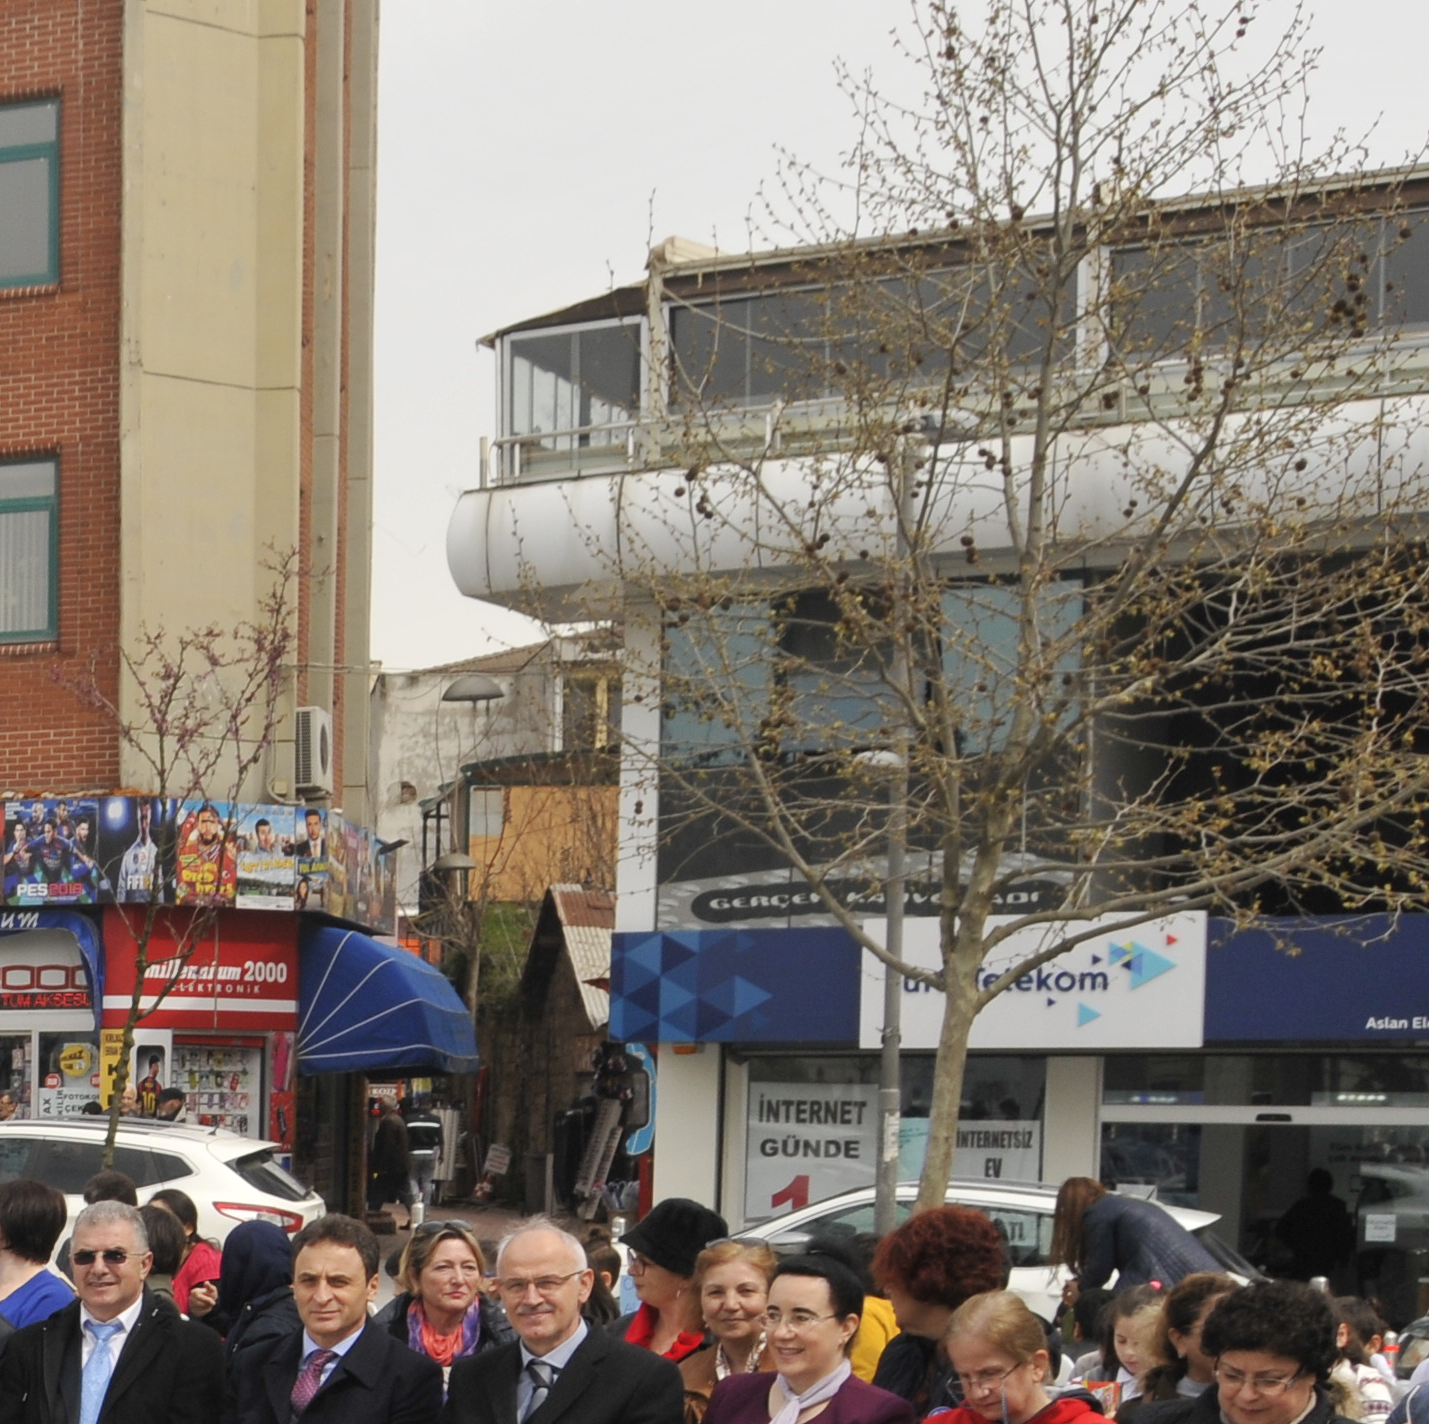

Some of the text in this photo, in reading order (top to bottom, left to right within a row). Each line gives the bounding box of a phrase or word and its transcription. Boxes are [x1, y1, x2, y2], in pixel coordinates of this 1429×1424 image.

[17, 883, 48, 897] PES
[845, 891, 942, 905] KAVE
[243, 960, 288, 983] 2000
[1365, 1016, 1409, 1031] Aslan
[64, 1104, 84, 1114] ÇEK
[143, 1091, 157, 1114] 10
[758, 1094, 868, 1126] İNTERNET
[759, 1134, 861, 1160] GÜNDE
[955, 1128, 1033, 1150] İNTERNETSİZ
[984, 1157, 1003, 1179] EV
[771, 1174, 810, 1211] 1
